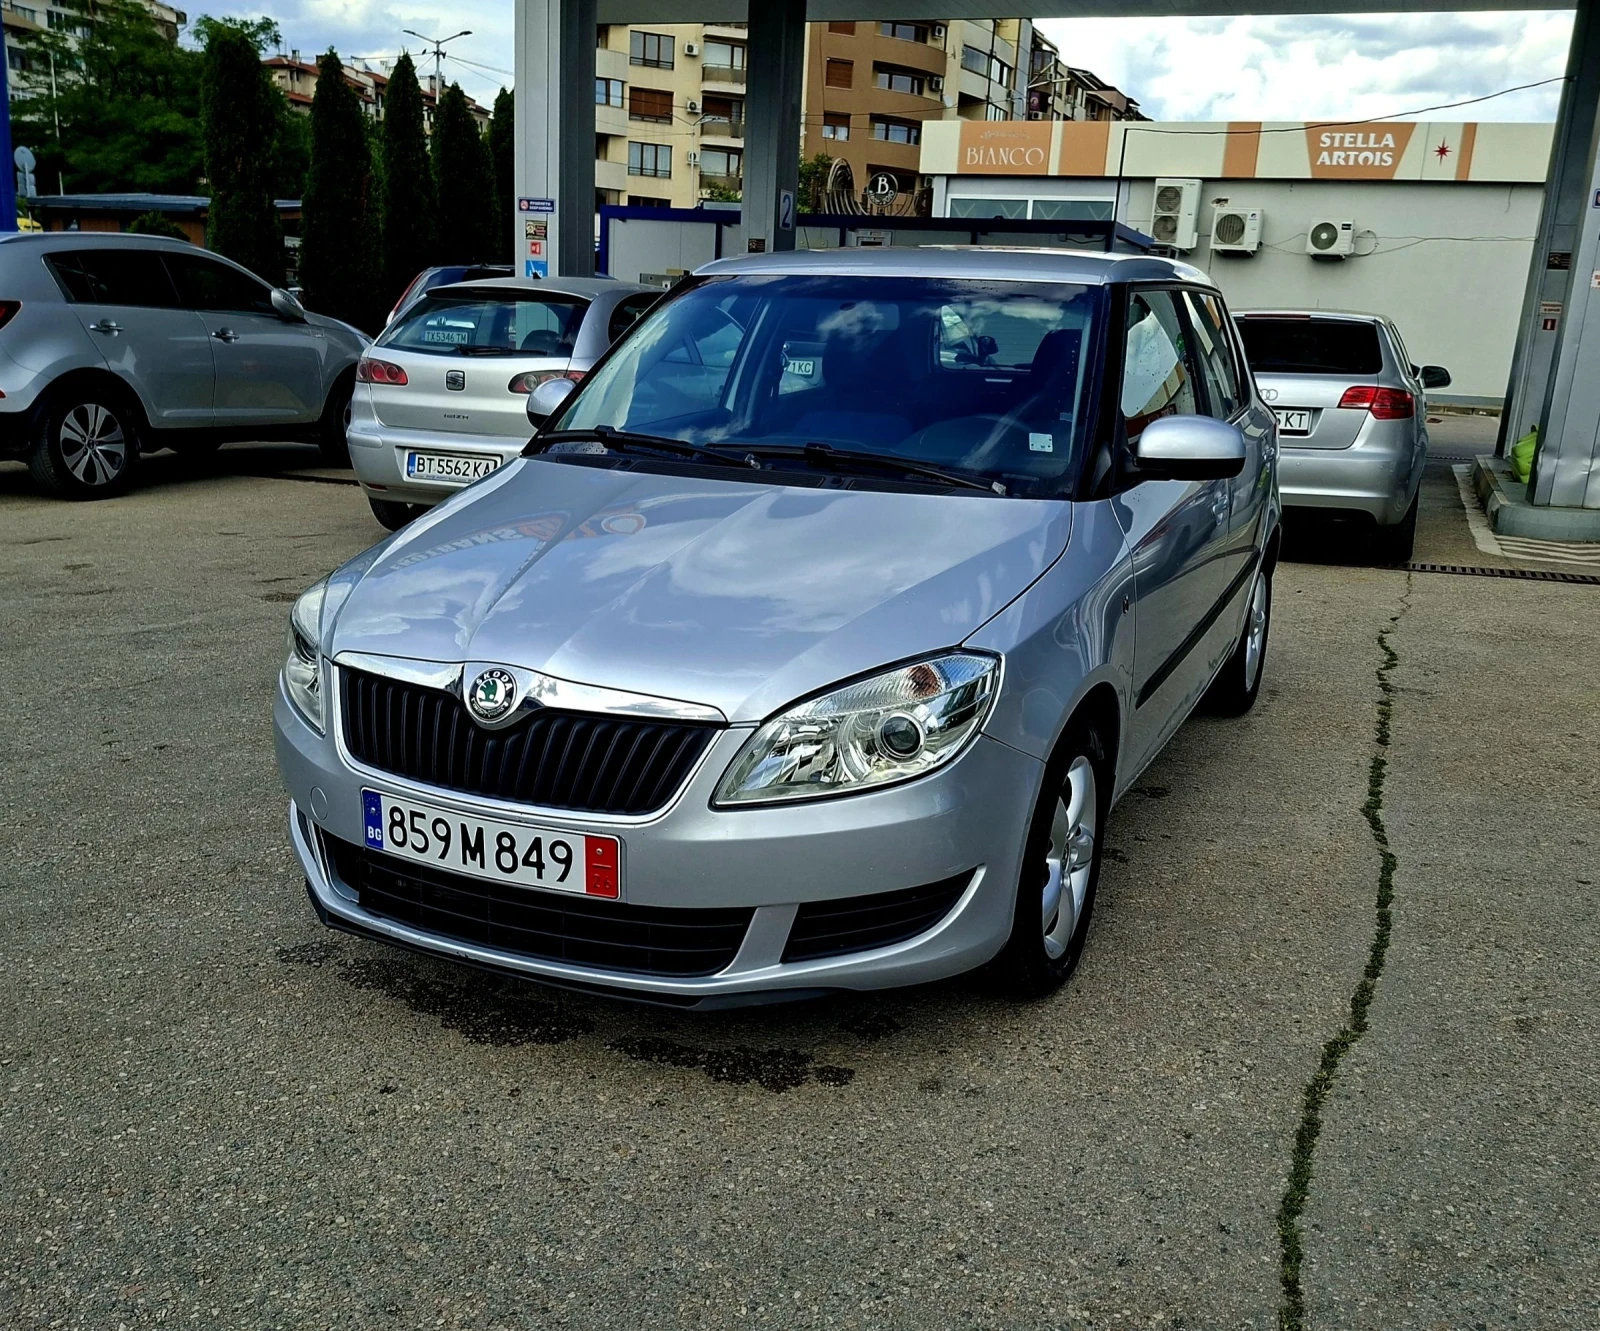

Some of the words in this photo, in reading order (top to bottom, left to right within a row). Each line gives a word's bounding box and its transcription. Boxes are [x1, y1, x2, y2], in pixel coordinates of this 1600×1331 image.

[1320, 132, 1396, 148] STELLA
[1316, 151, 1394, 167] ARTOIS
[875, 176, 889, 195] B
[781, 194, 792, 229] 2
[416, 457, 435, 474] BT
[437, 458, 471, 477] 5562
[367, 825, 382, 842] BG
[388, 805, 451, 860] 859
[460, 822, 486, 870] M
[495, 831, 573, 883] 849
